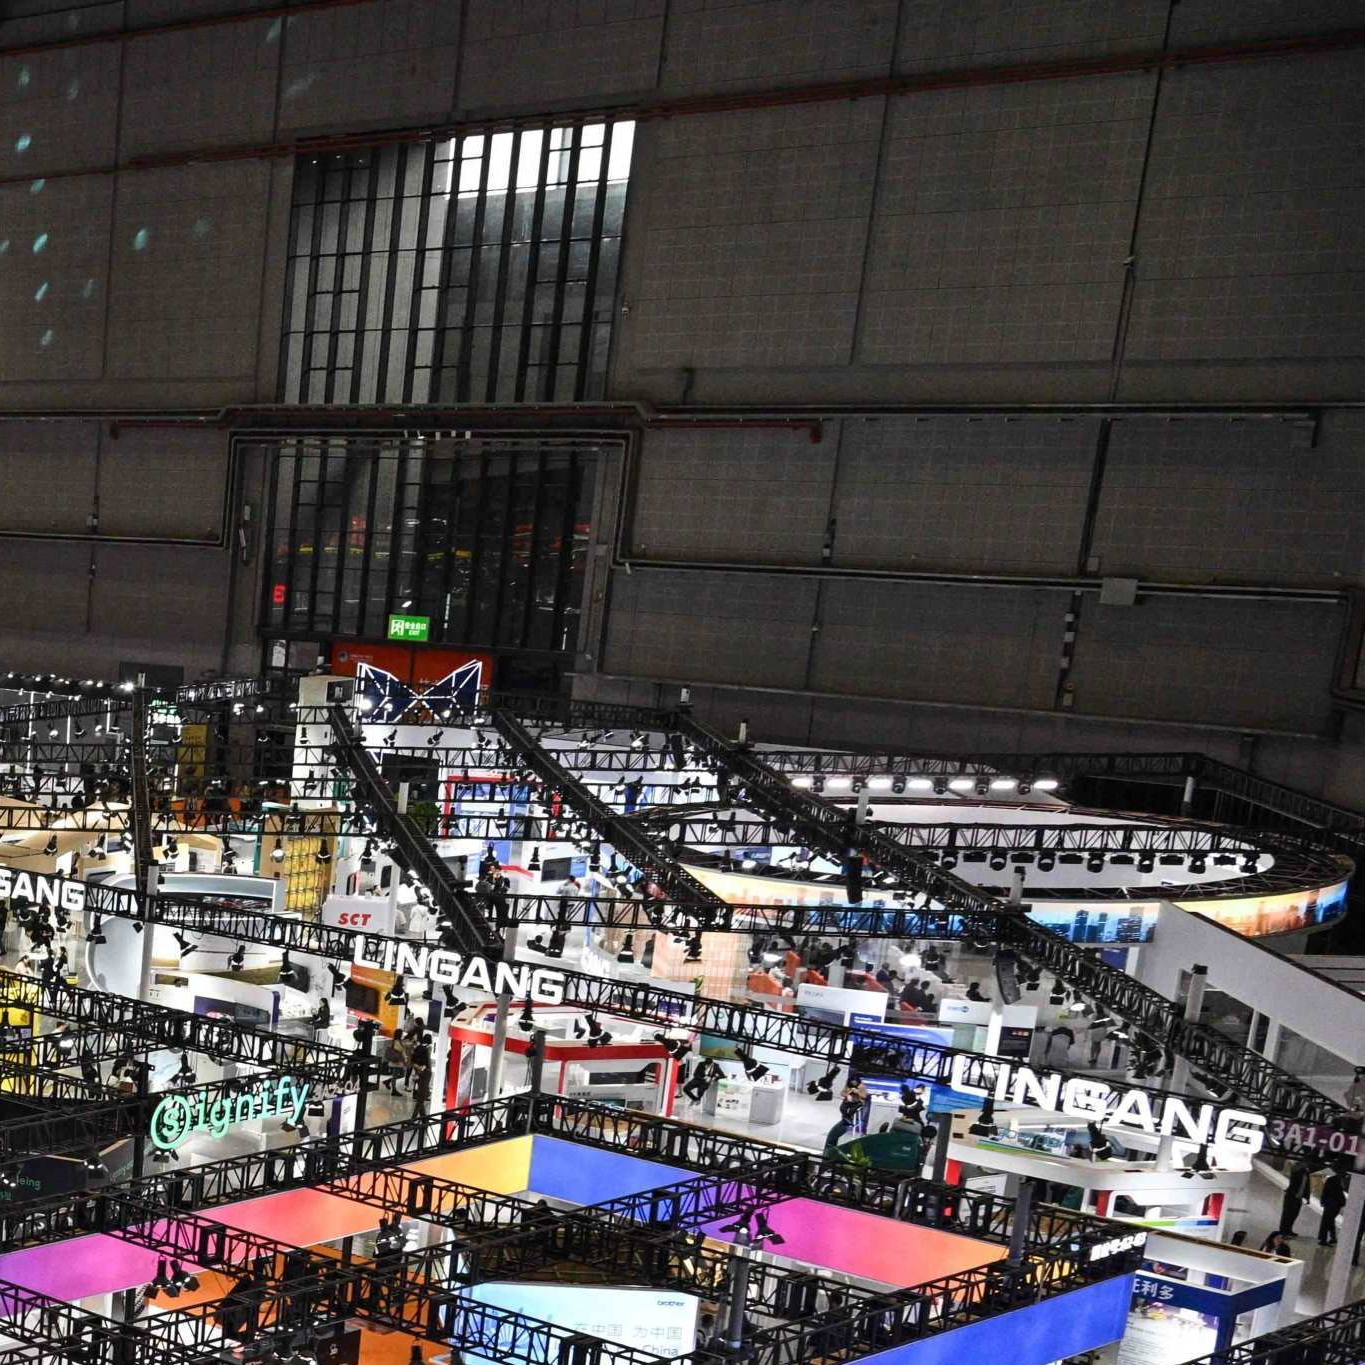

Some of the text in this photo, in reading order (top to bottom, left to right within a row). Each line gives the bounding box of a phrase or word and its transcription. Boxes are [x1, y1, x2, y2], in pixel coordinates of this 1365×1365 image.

[336, 912, 373, 926] SCT
[353, 936, 570, 1005] LINGANG
[150, 1074, 312, 1151] Signify
[951, 1054, 1268, 1154] LINGANG
[1272, 1117, 1360, 1158] 3A1-01
[632, 1325, 683, 1340] 为中国
